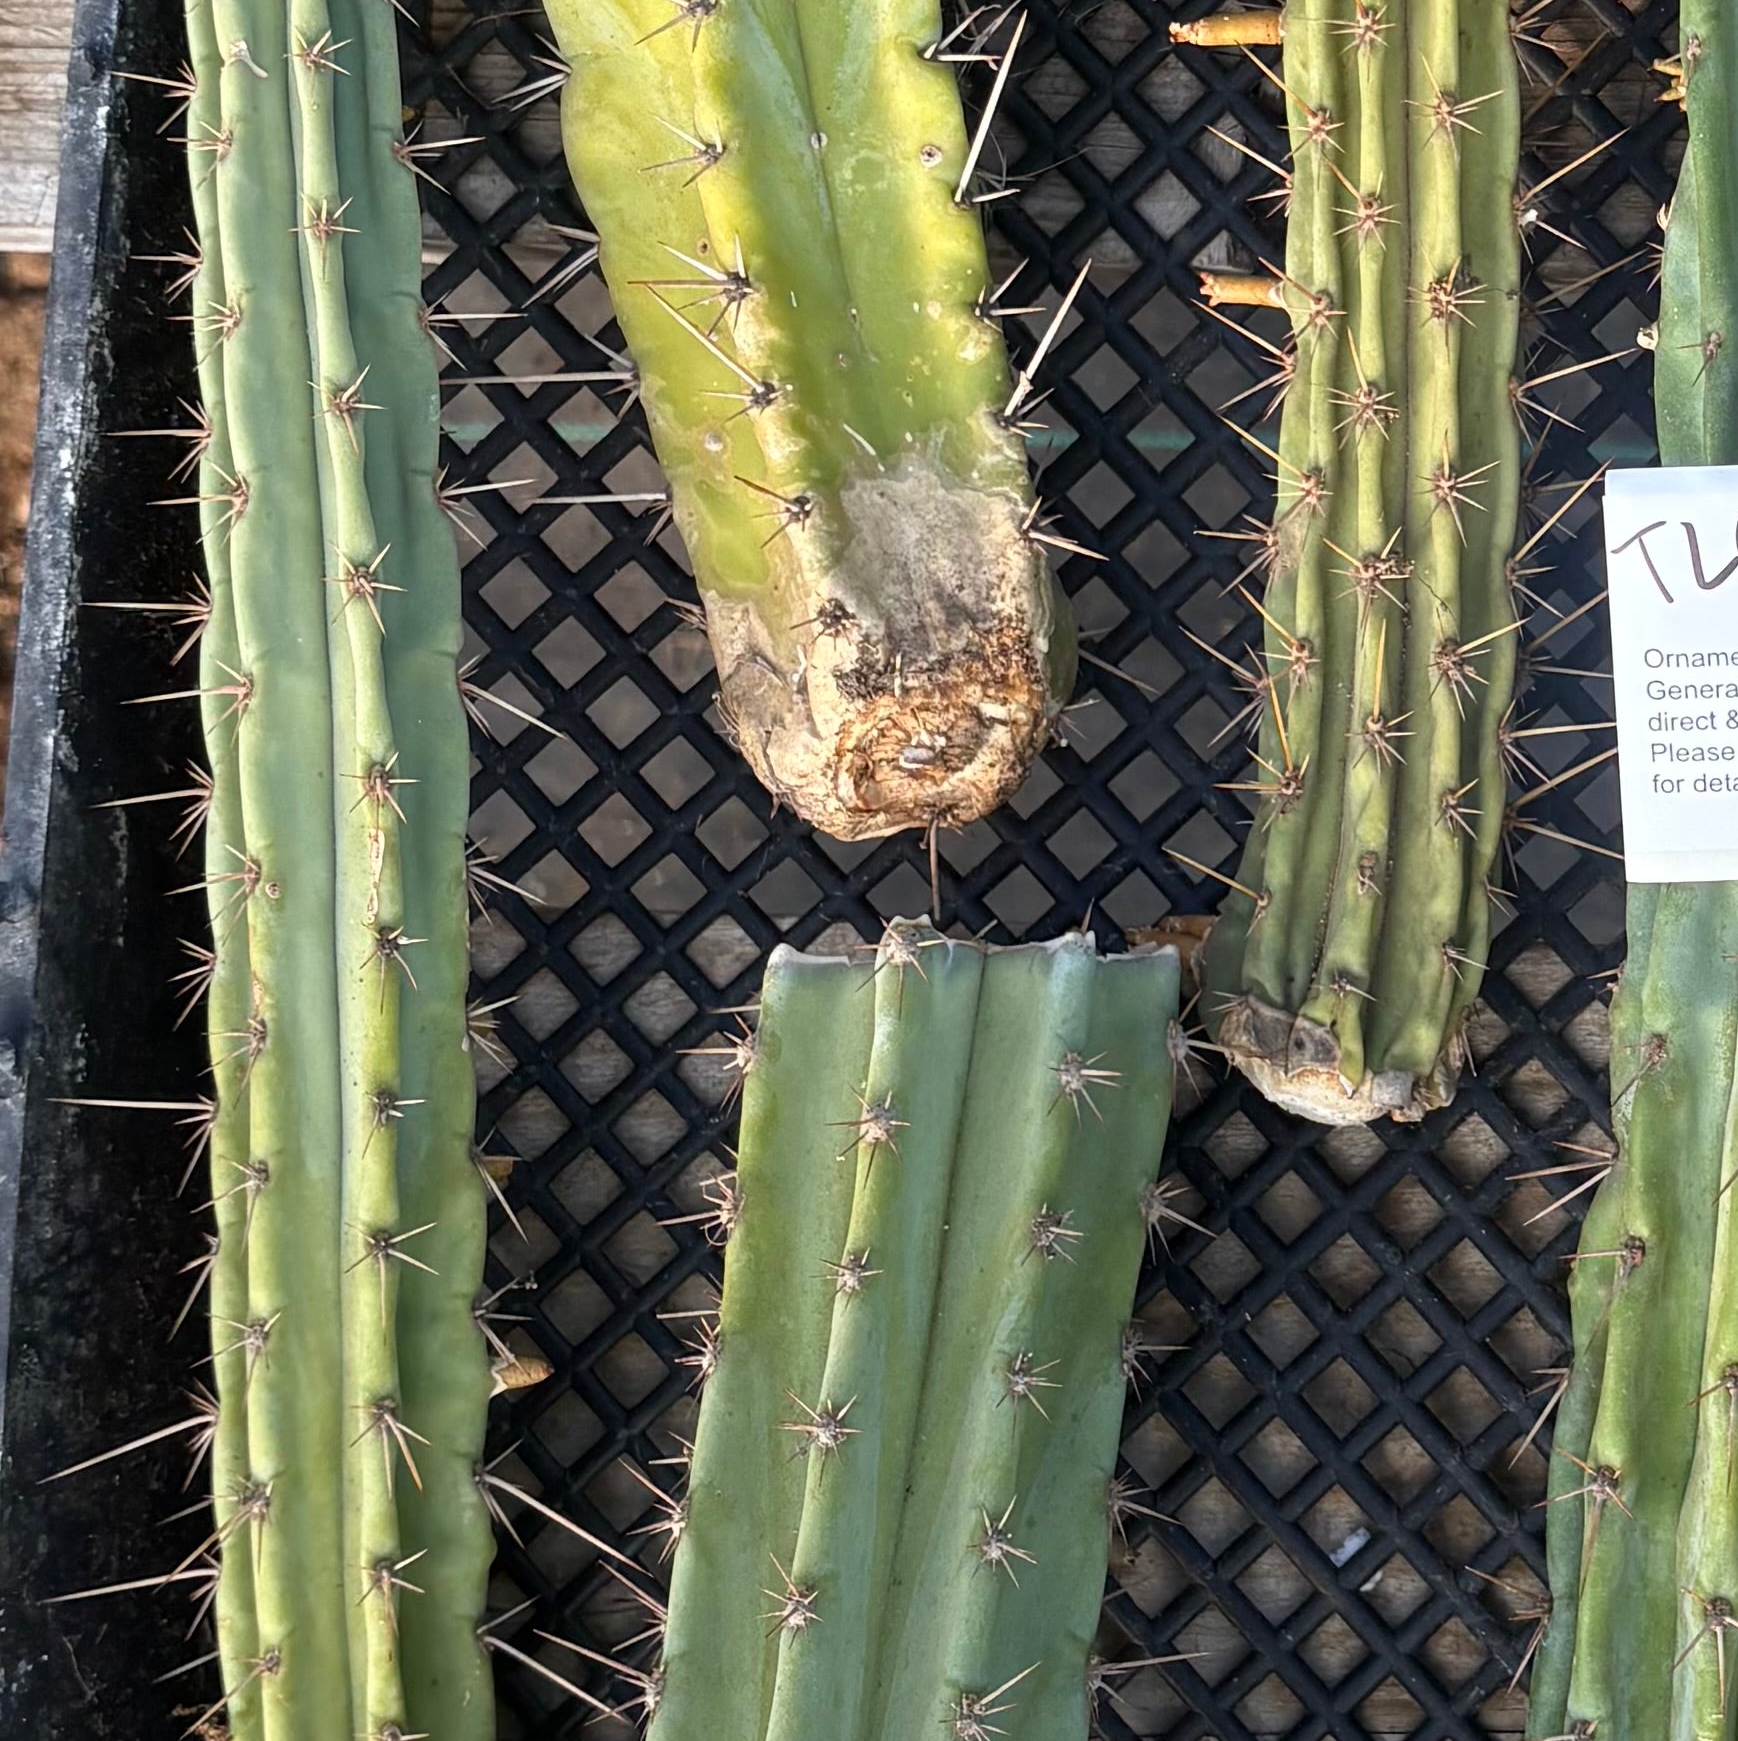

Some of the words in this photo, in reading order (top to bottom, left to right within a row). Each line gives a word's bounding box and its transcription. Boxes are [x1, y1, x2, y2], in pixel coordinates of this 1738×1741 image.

[1649, 711, 1716, 732] direct
[1651, 742, 1735, 762] Please
[1653, 774, 1684, 793] for
